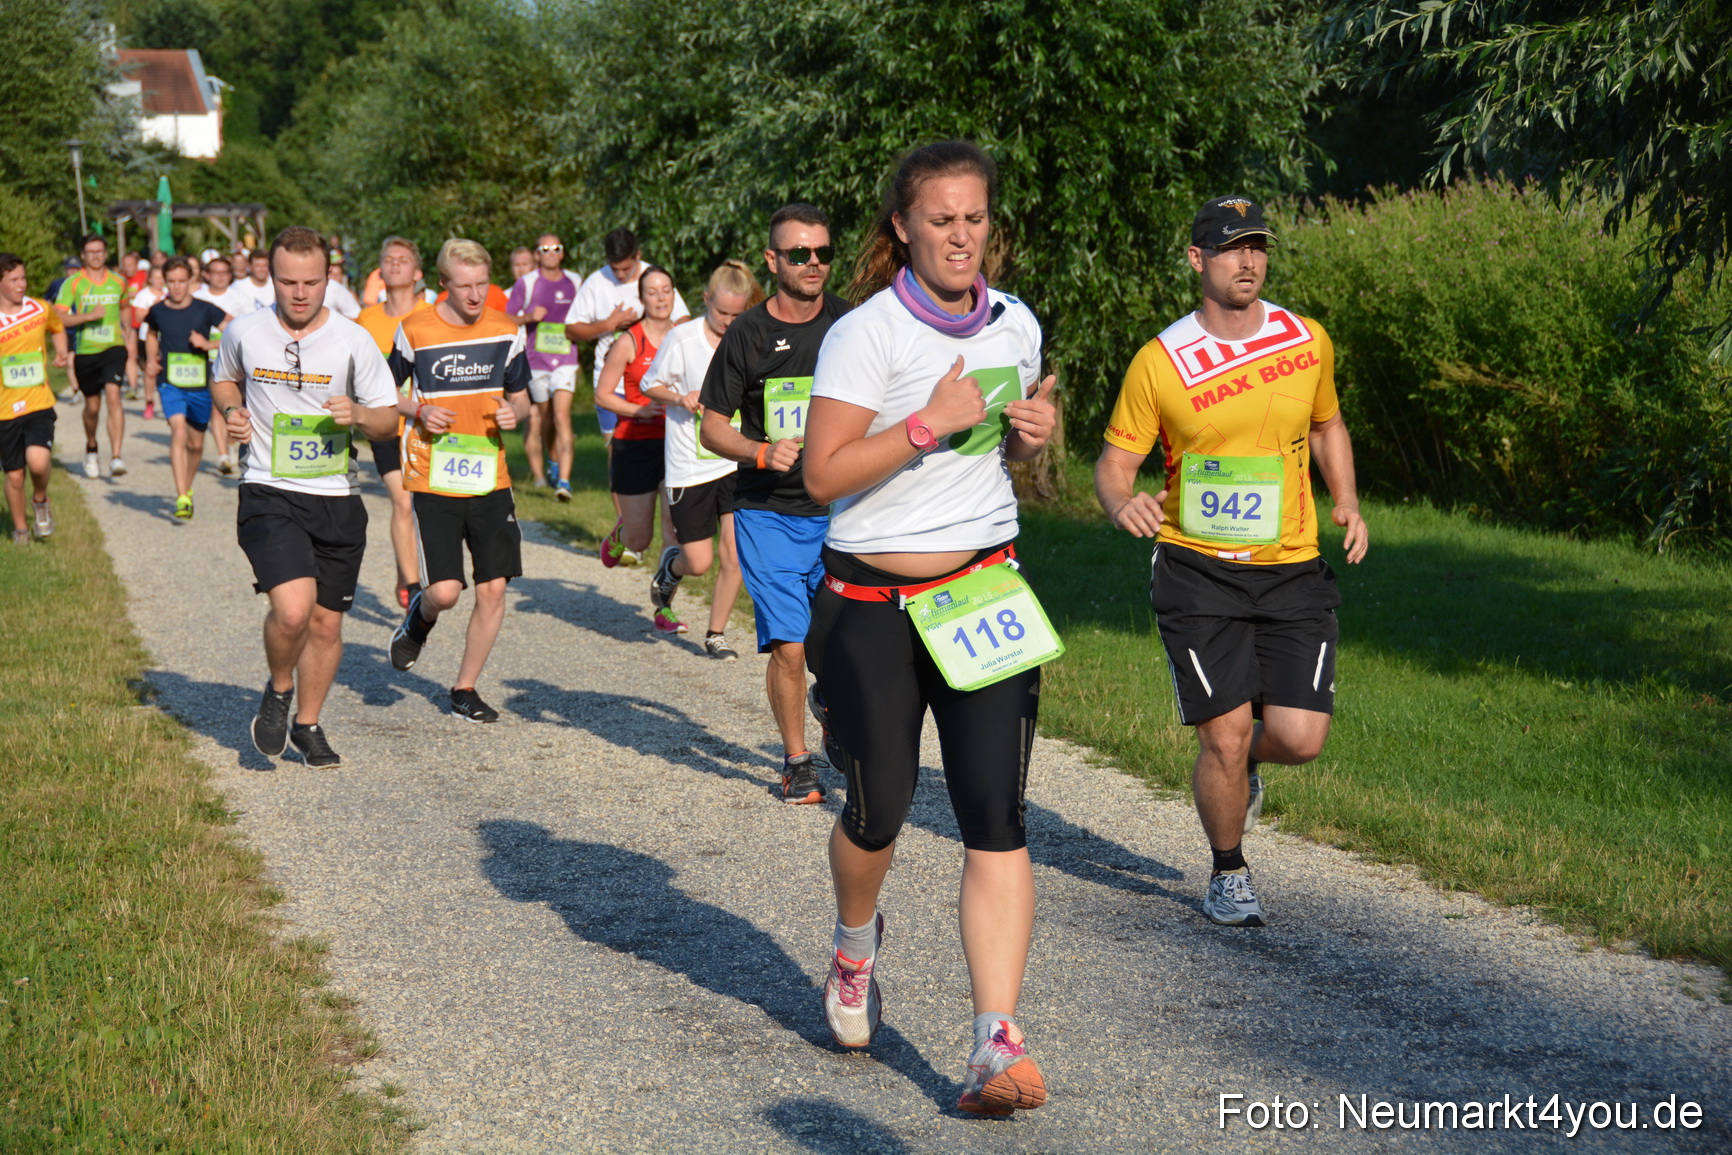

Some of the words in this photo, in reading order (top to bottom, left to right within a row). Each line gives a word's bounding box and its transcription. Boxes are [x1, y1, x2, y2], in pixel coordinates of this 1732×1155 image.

[10, 366, 35, 379] 941
[444, 364, 494, 377] Fischer
[450, 374, 490, 382] AUTOMOBILE
[1190, 374, 1255, 413] MAX
[1258, 350, 1320, 384] BÖGL
[774, 406, 801, 429] 11
[289, 440, 335, 461] 534
[443, 457, 483, 478] 464
[1200, 490, 1262, 520] 942
[1211, 524, 1229, 532] Ralph
[1230, 525, 1250, 533] Walter
[931, 596, 969, 616] firmenlauf
[952, 609, 1026, 659] 118
[980, 658, 998, 671] Julia
[996, 648, 1025, 665] Warstat
